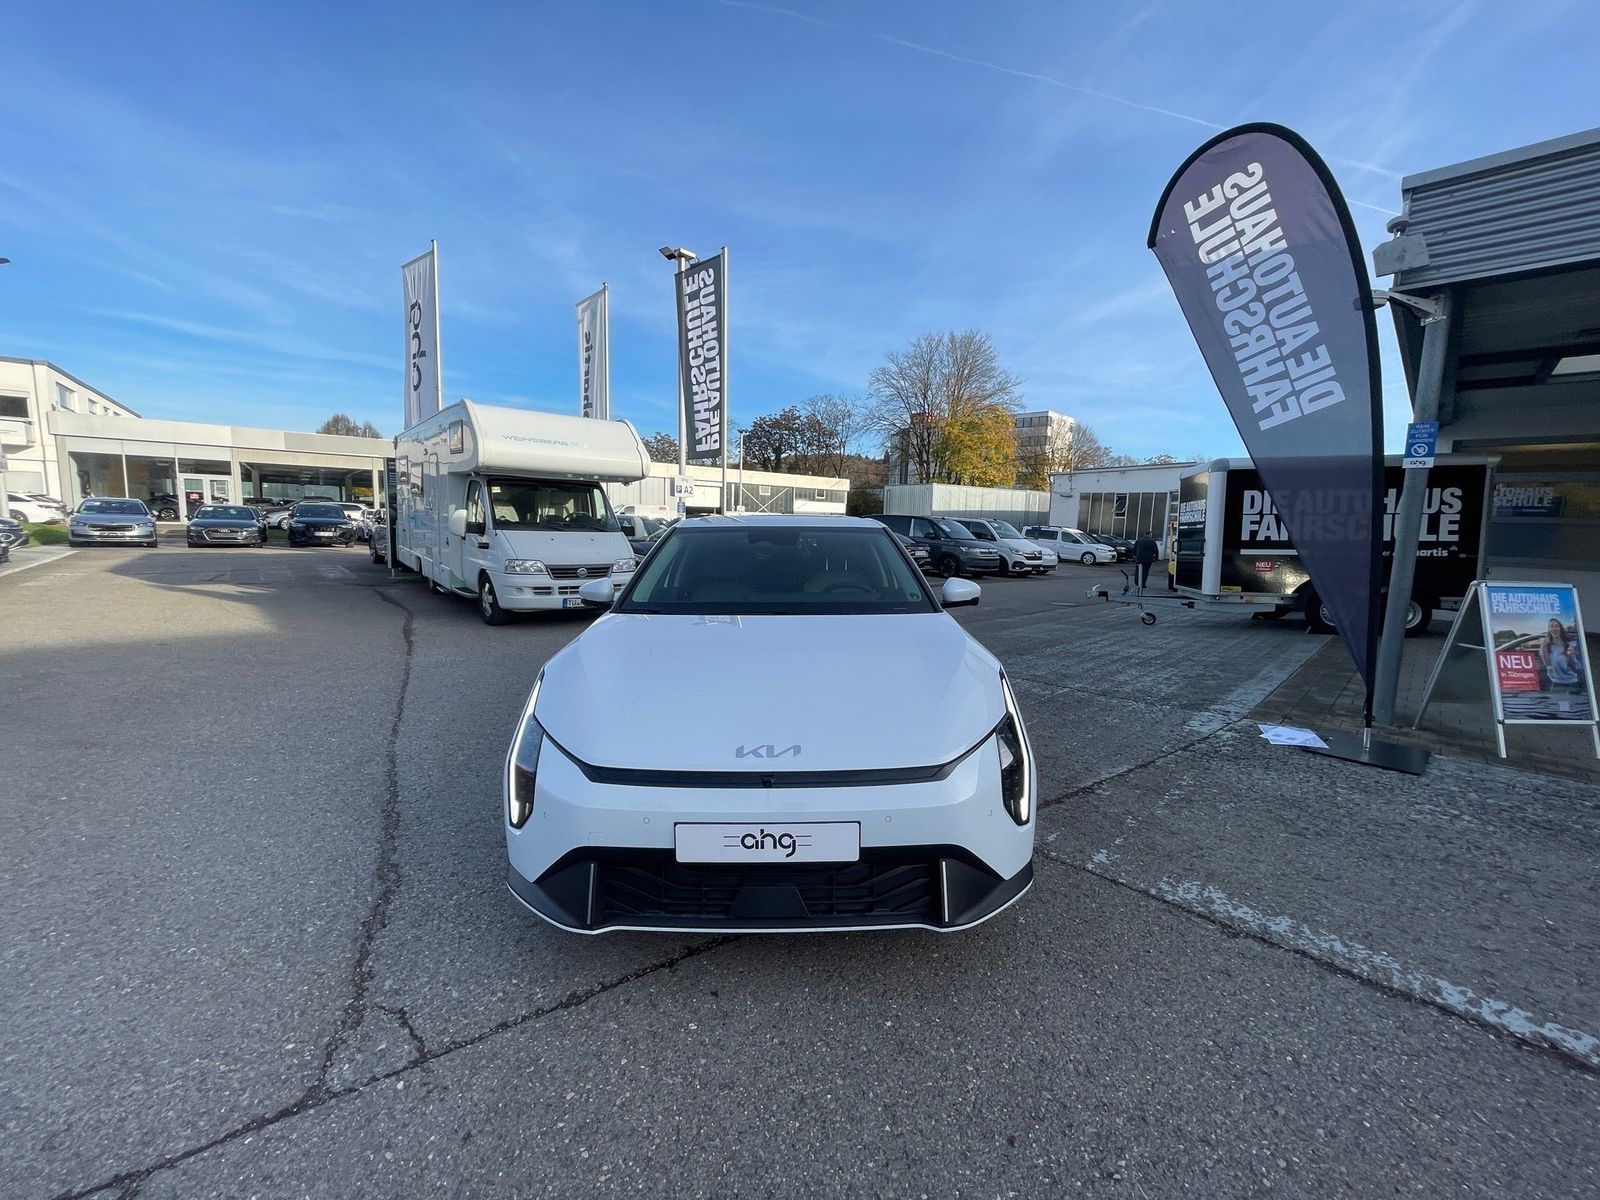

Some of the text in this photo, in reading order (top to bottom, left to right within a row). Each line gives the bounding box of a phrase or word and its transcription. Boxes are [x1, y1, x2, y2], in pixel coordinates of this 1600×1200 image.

[684, 486, 694, 494] A2
[1491, 593, 1560, 603] DIE AUTOHAUS
[1492, 602, 1561, 614] FAHRSCHULE
[1500, 655, 1533, 669] NEU
[735, 744, 802, 759] KIA
[740, 828, 797, 859] ahg
